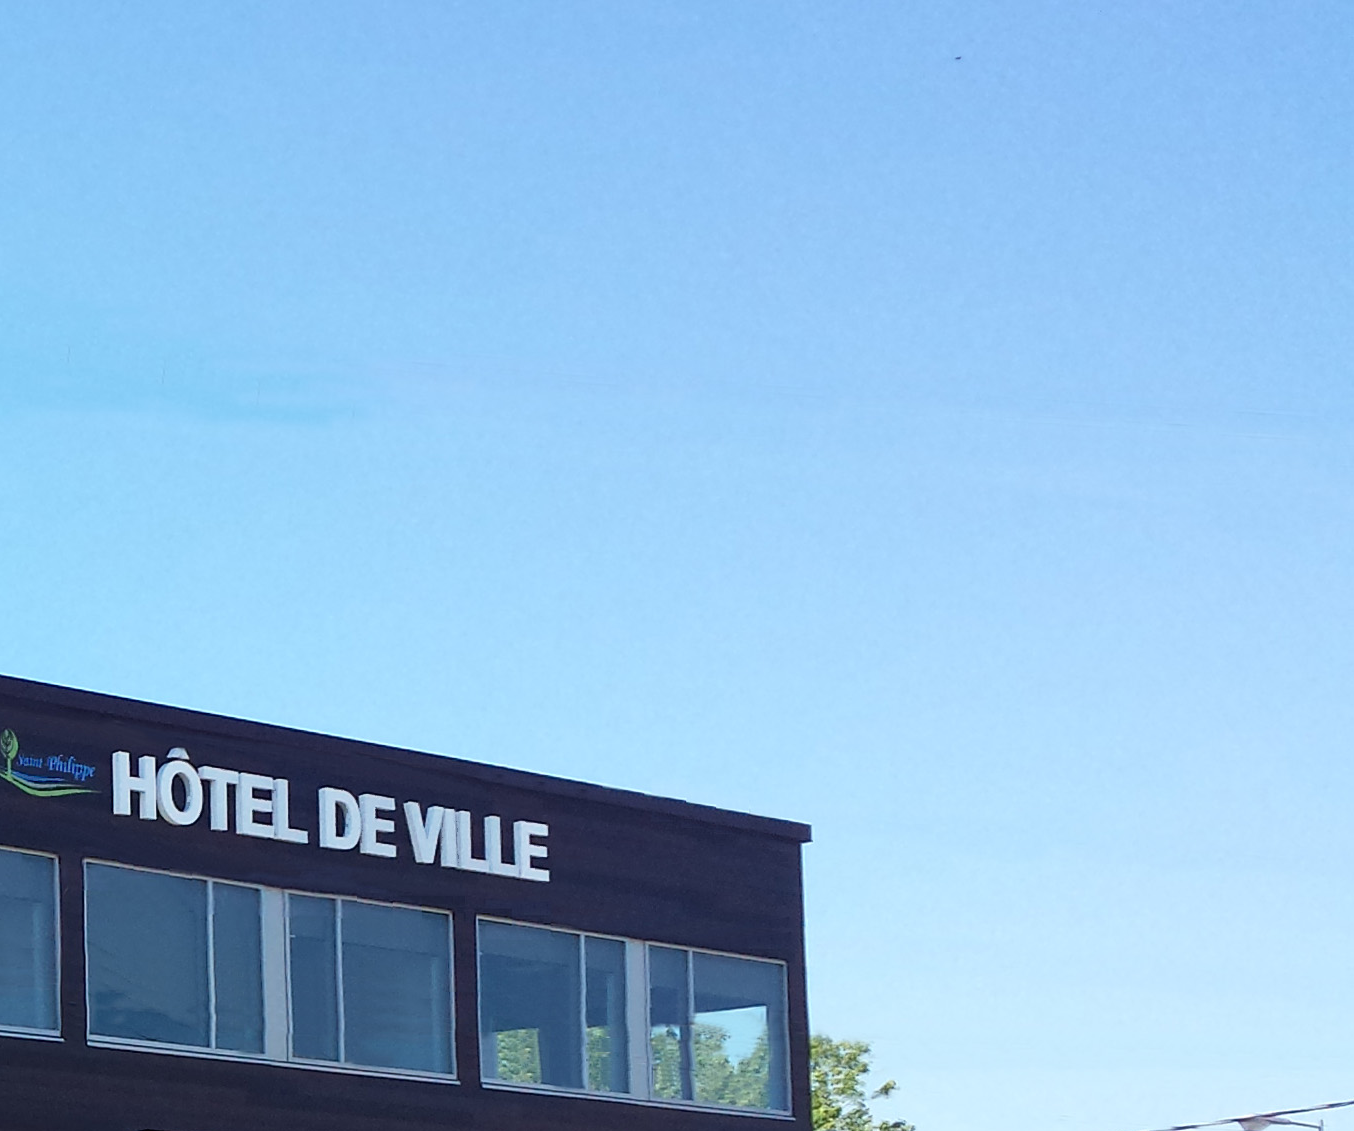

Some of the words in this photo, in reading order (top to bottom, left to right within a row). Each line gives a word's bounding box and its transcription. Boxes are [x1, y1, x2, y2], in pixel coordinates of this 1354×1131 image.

[47, 754, 96, 781] Philippe
[112, 747, 308, 844] HÔTEL
[319, 786, 396, 858] DE
[403, 801, 550, 882] VILLE
